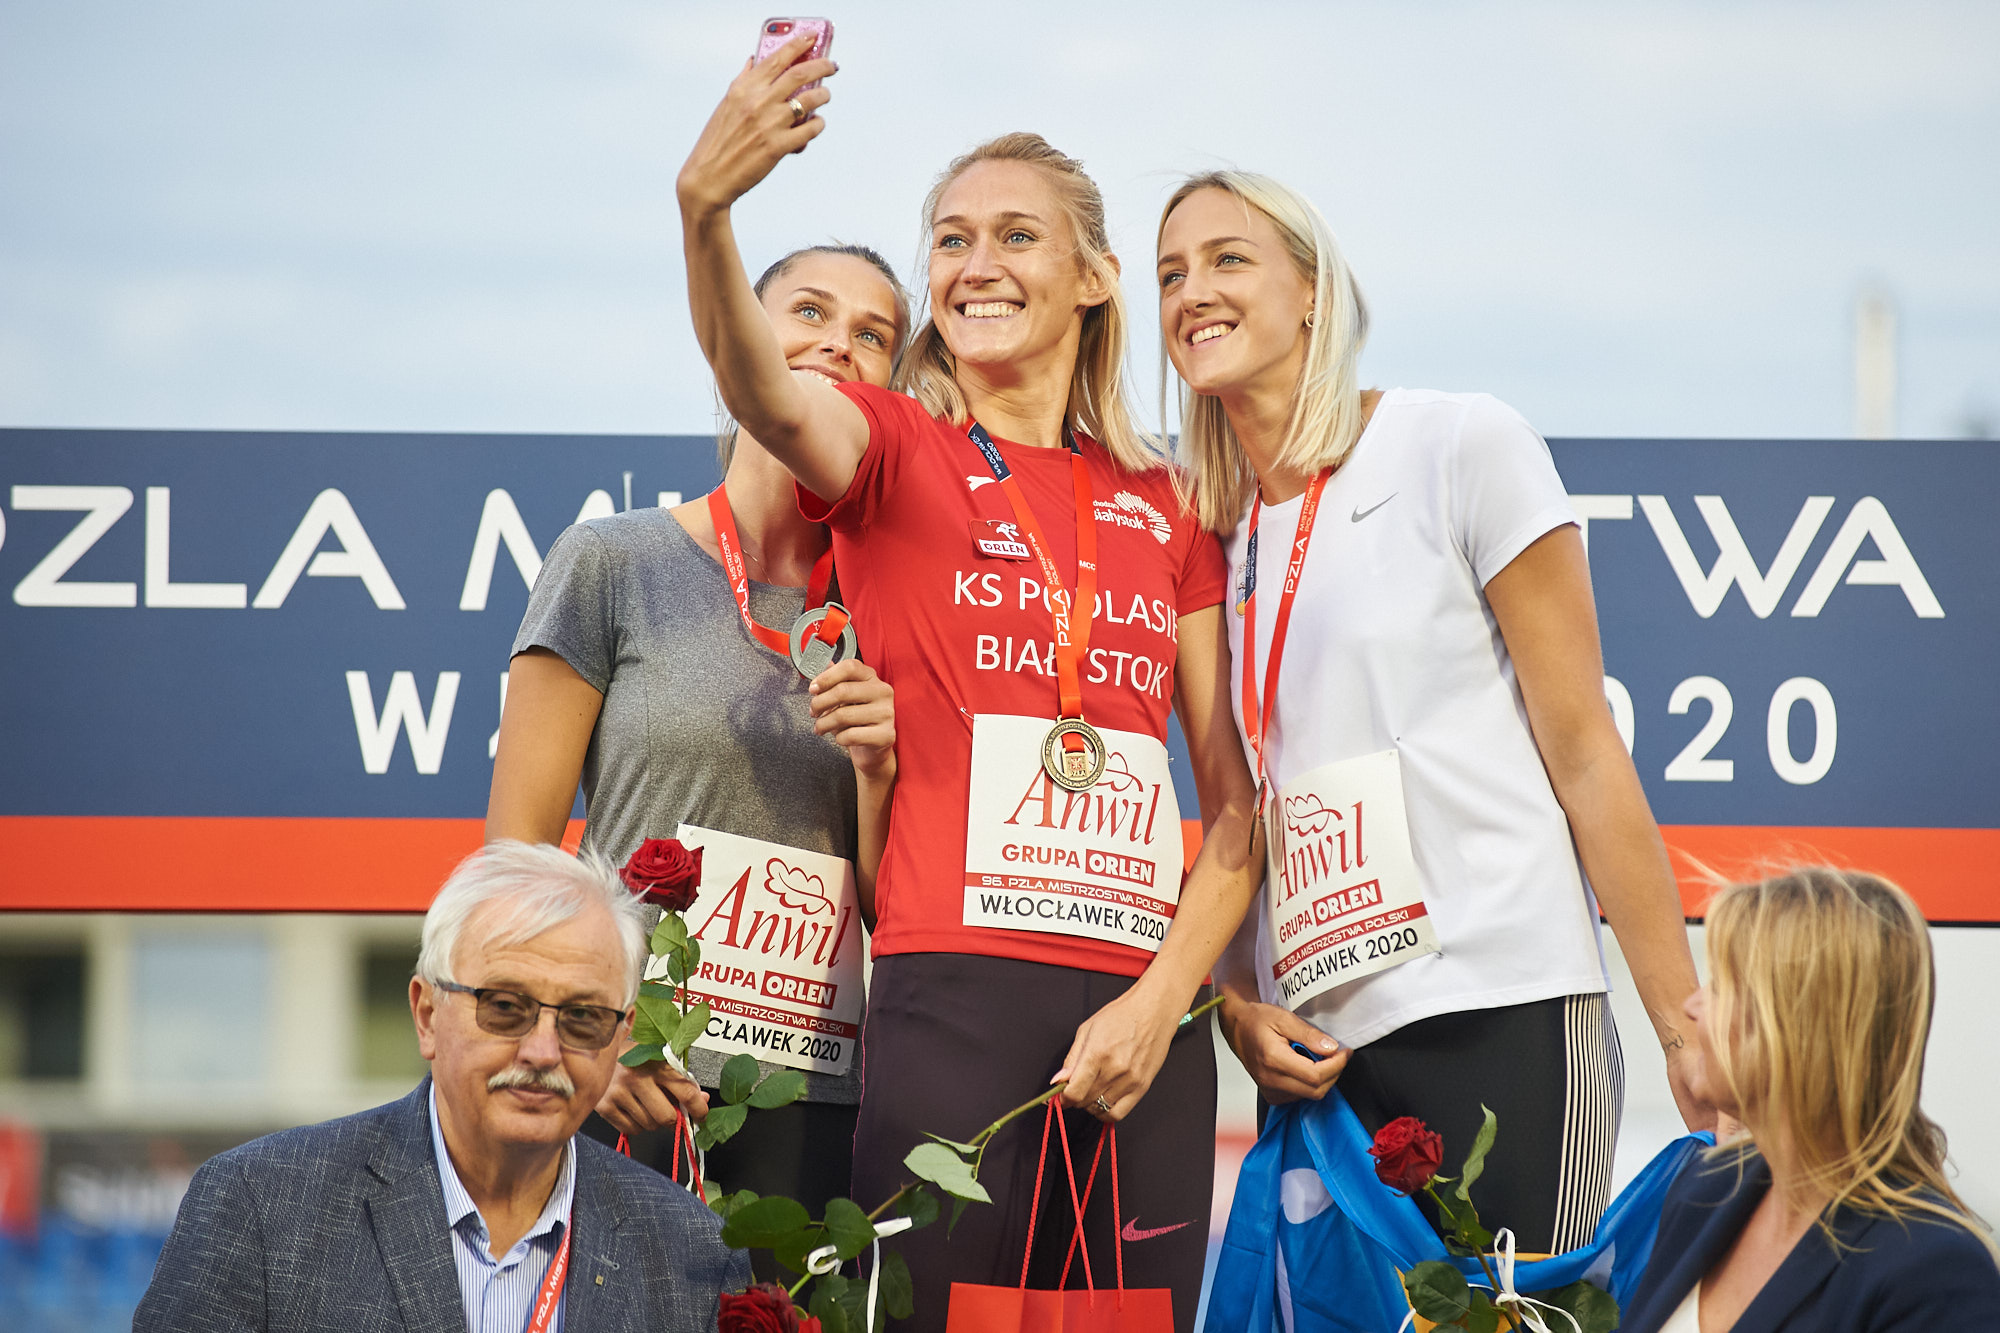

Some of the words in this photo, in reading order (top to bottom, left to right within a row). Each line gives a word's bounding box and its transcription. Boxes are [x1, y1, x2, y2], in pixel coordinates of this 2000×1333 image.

[1299, 473, 1320, 532] MISTRZOSTW
[0, 484, 407, 610] ZLA
[983, 542, 1026, 554] ORLEN
[1284, 536, 1308, 594] PZLA
[953, 571, 1003, 607] KS
[1019, 576, 1179, 645] POLASIE
[1052, 588, 1072, 647] PZLA
[975, 634, 1169, 699] BIAŁSTOK
[1003, 763, 1162, 846] Anwil
[1001, 843, 1081, 869] GRUPA
[1088, 853, 1153, 884] ORLEN
[1276, 800, 1369, 909] Anwil
[690, 866, 852, 969] Anwil
[980, 894, 1126, 931] WŁOCŁAWEK
[1130, 914, 1165, 942] 2020
[981, 874, 1005, 888] 96.
[1008, 878, 1045, 891] PZLA
[1047, 883, 1134, 905] MISTRZOSTWA
[1135, 897, 1166, 914] POLSKI
[1279, 910, 1314, 944] GRUPA
[1314, 884, 1379, 922] ORLEN
[1301, 924, 1364, 959] MISTRZOSTWA
[1365, 910, 1410, 931] POLSKI
[766, 975, 834, 1006] ORLEN
[1281, 944, 1361, 1002] WŁOCŁAWEK
[1365, 927, 1419, 960] 2020
[704, 1016, 796, 1054] CŁAWEK
[797, 1035, 842, 1063] 2020
[718, 1000, 808, 1028] MISTRZOSTWA
[808, 1019, 844, 1035] POLSKI
[535, 1290, 553, 1328] PZLA
